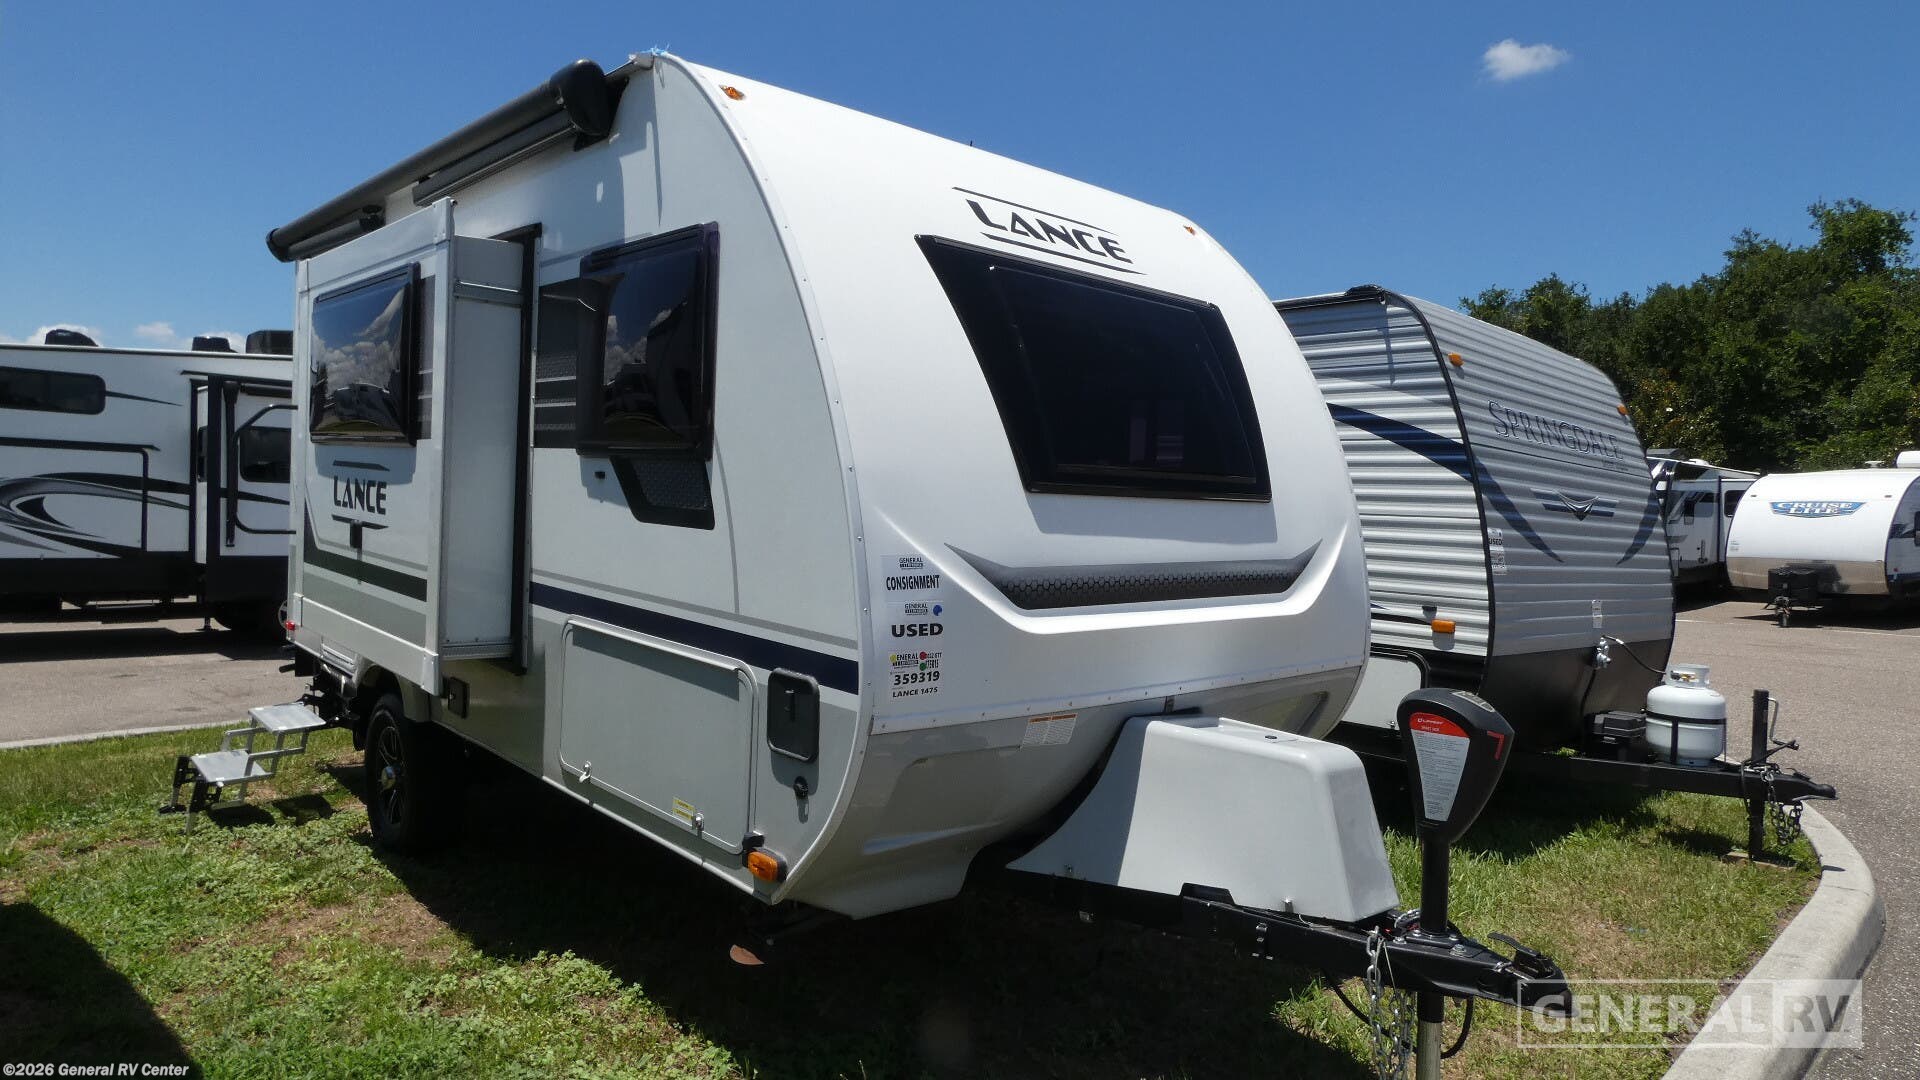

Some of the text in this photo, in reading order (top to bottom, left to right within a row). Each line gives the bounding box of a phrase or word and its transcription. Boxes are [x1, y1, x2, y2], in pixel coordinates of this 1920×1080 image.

[965, 199, 1134, 264] LANCE
[1488, 400, 1625, 459] SPRINGDALE
[333, 475, 387, 515] LANCE
[1777, 501, 1854, 509] CRUISE
[886, 574, 940, 591] CONSIGNMENT
[891, 623, 944, 638] USED
[892, 652, 918, 661] ENERAL
[893, 670, 940, 686] 359319
[892, 686, 938, 698] LANCE 1475
